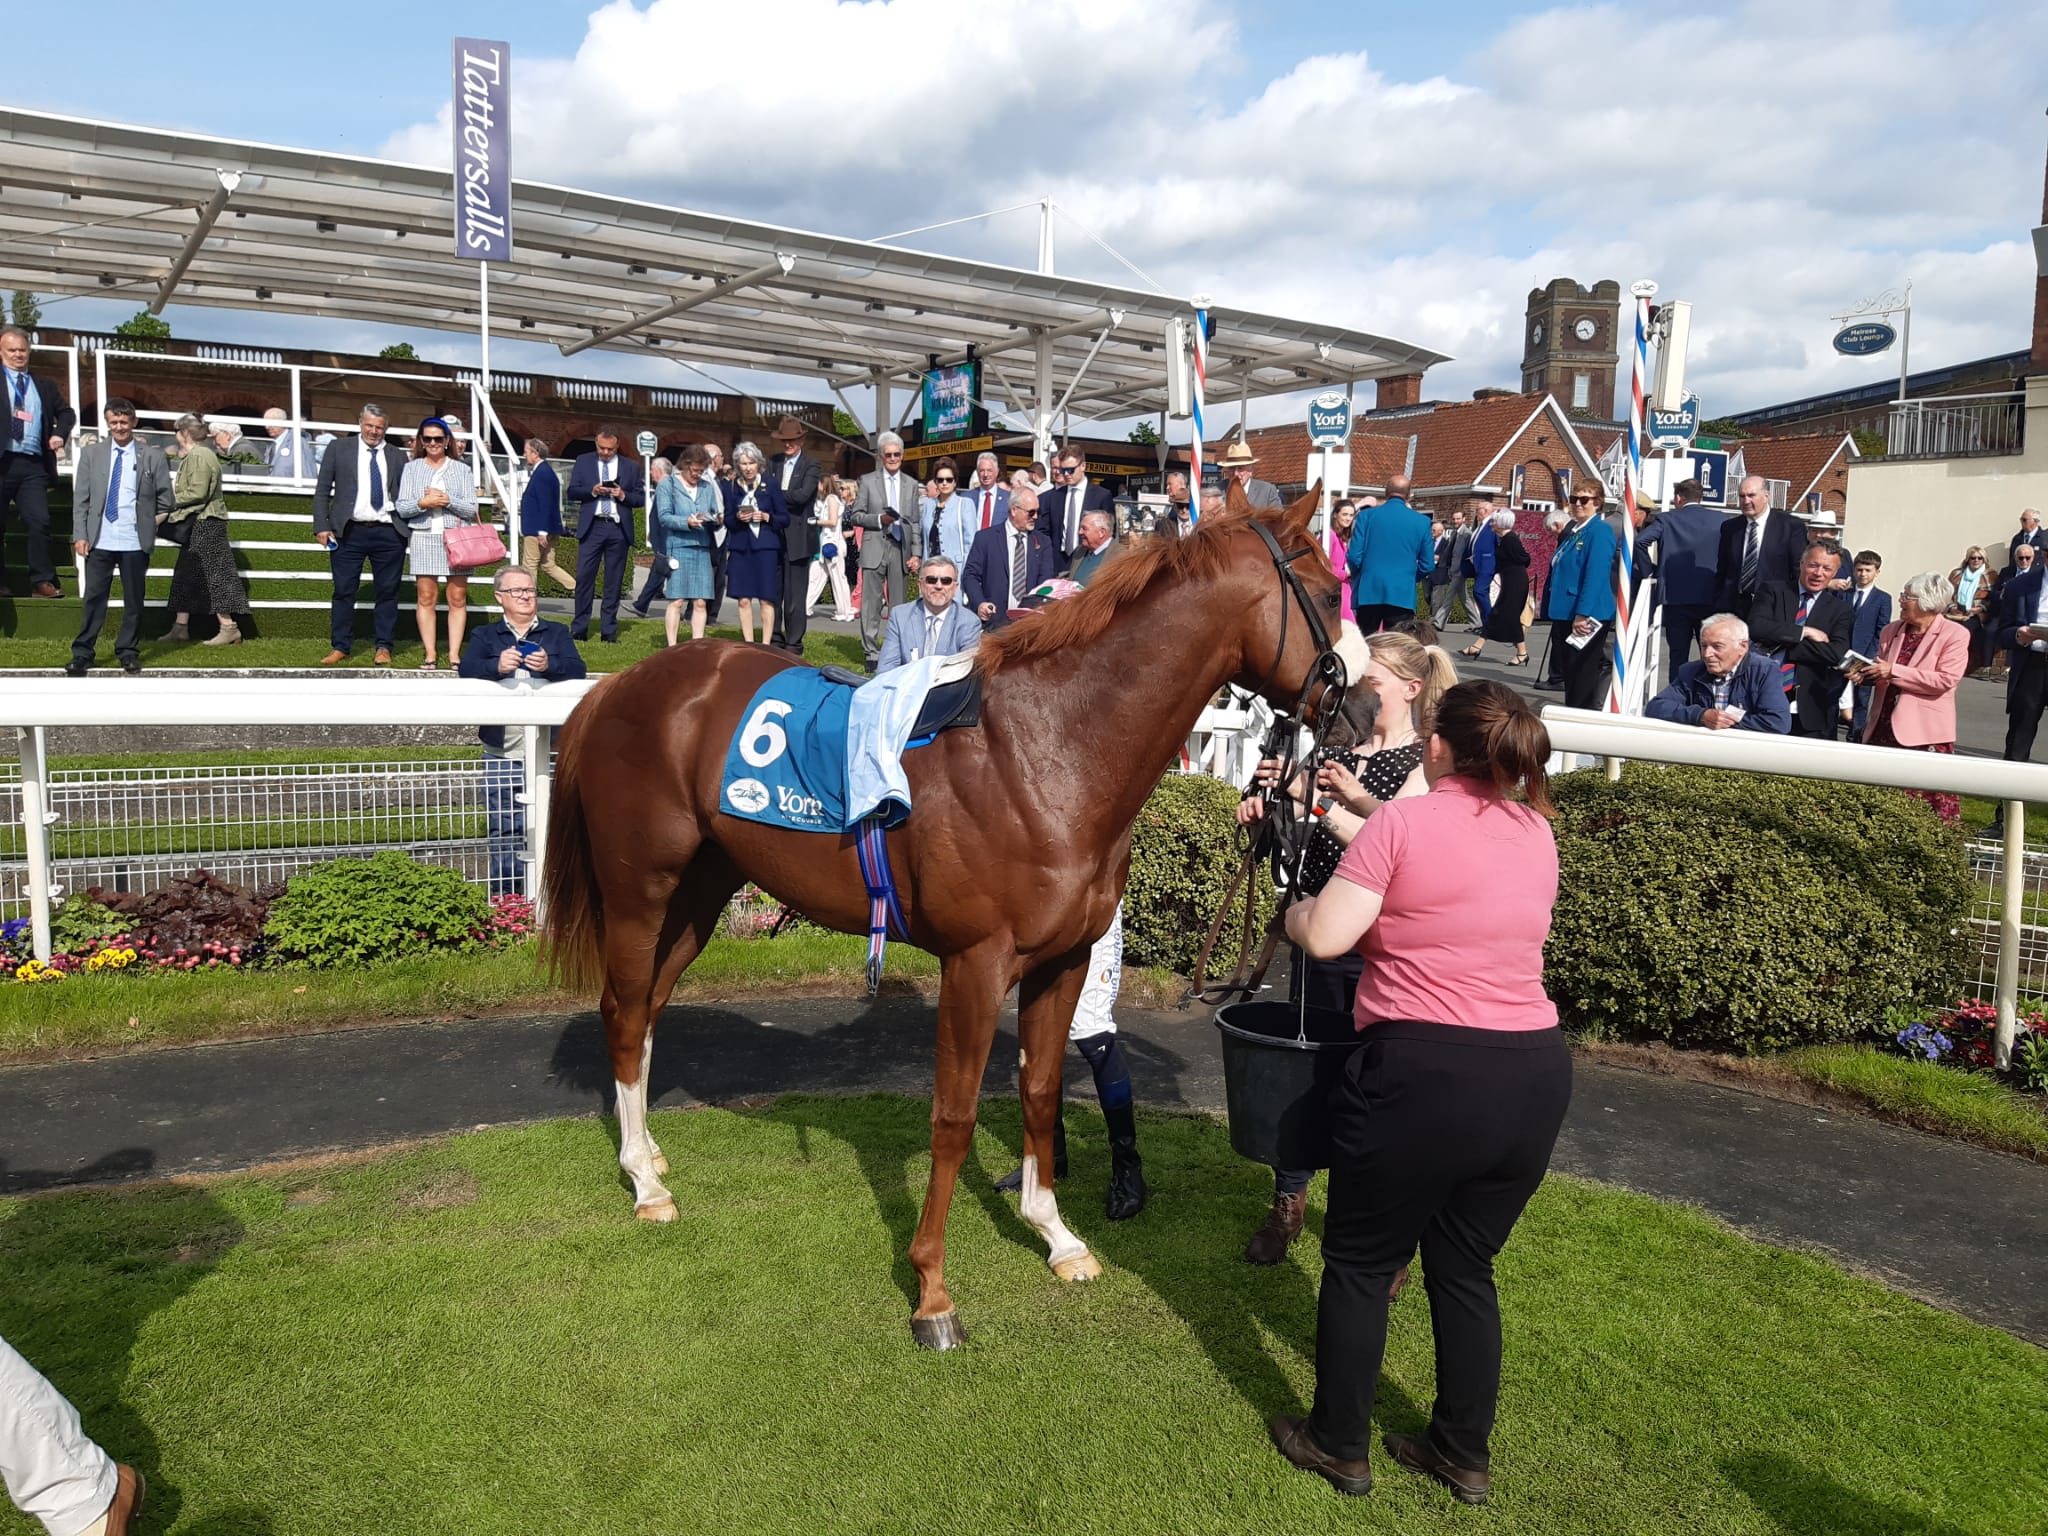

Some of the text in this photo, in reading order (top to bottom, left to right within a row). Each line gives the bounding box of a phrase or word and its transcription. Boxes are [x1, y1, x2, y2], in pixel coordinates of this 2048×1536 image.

[463, 48, 505, 252] Tattersalls
[1850, 328, 1877, 336] Melrose
[1859, 334, 1885, 342] Lounge
[1313, 412, 1346, 426] York
[1654, 410, 1693, 425] York
[921, 447, 930, 456] THE
[931, 444, 949, 455] FLYING
[739, 698, 793, 768] 6
[776, 785, 825, 817] York
[1113, 926, 1122, 974] ENERGY
